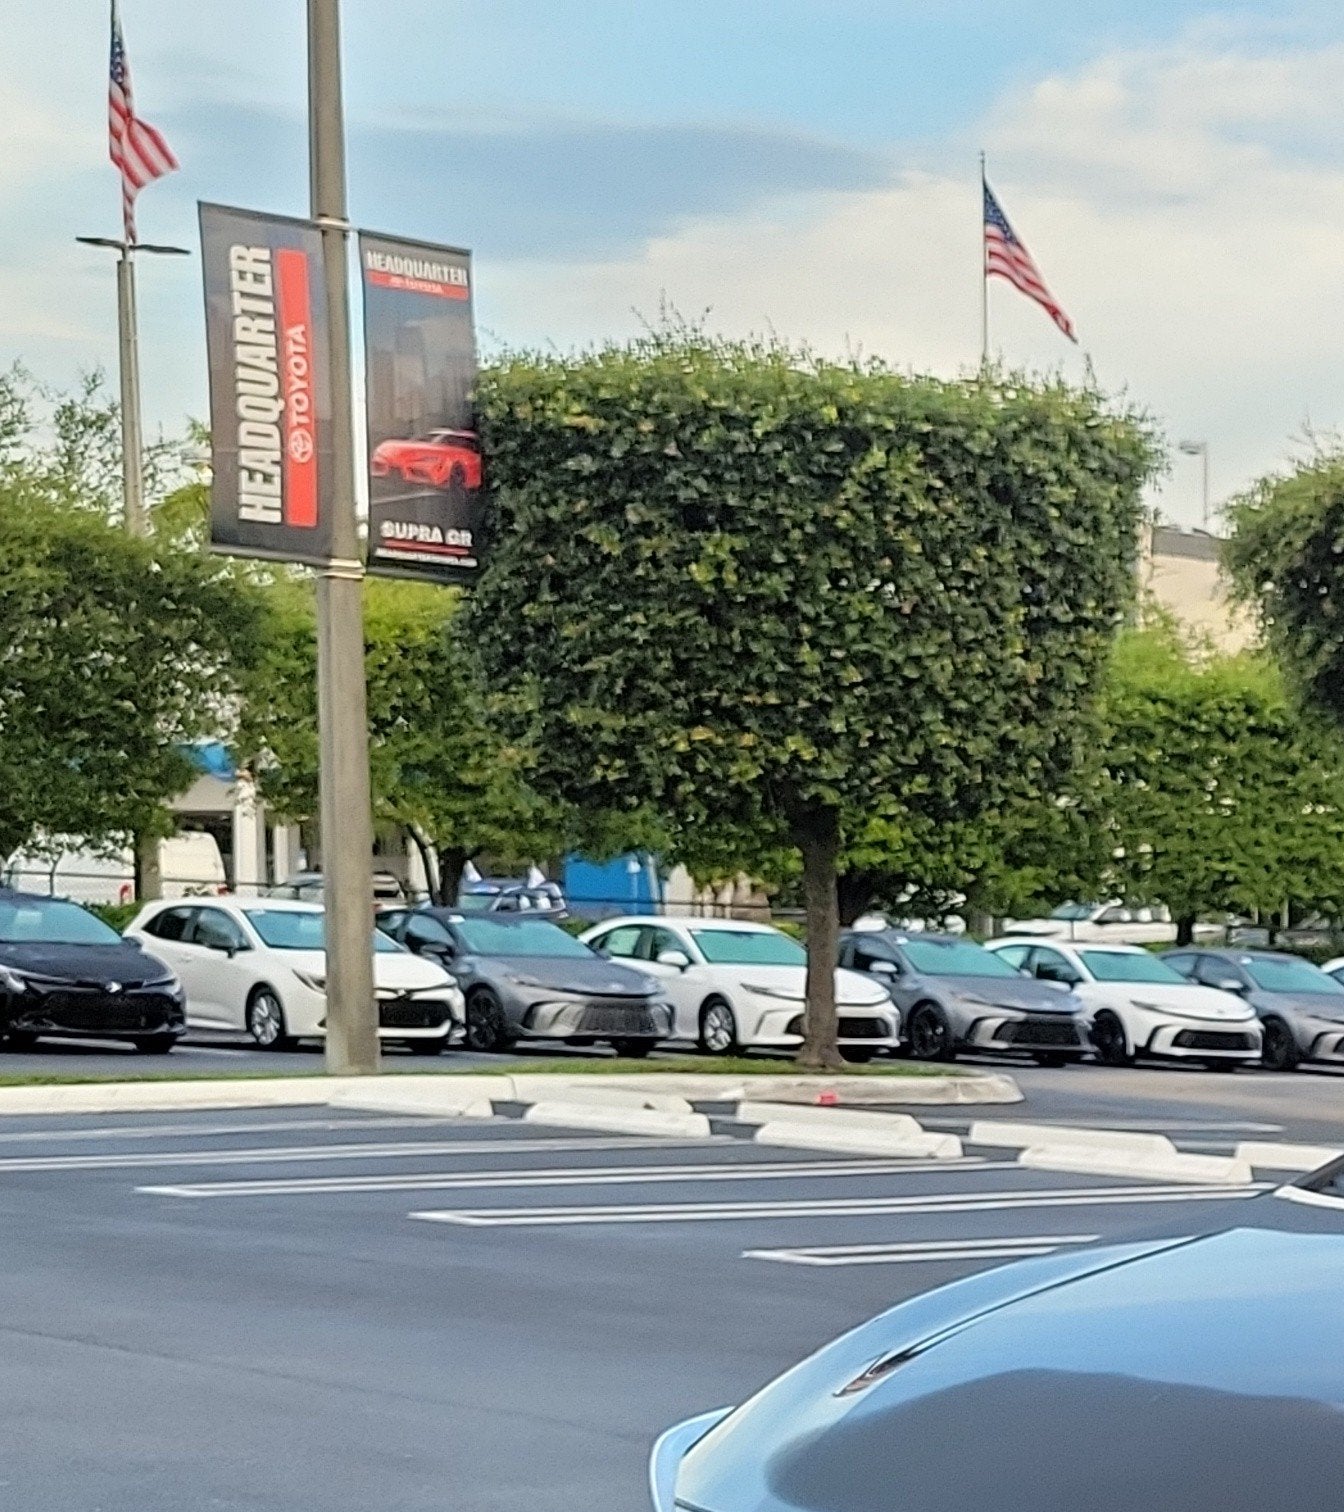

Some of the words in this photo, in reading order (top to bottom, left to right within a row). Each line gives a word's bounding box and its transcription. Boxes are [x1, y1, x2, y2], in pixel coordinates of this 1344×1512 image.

[367, 249, 468, 286] HEADQUARTER
[230, 244, 283, 524] HEADQUARTER
[285, 324, 312, 429] TOYOTA
[380, 519, 444, 543] SUPRA
